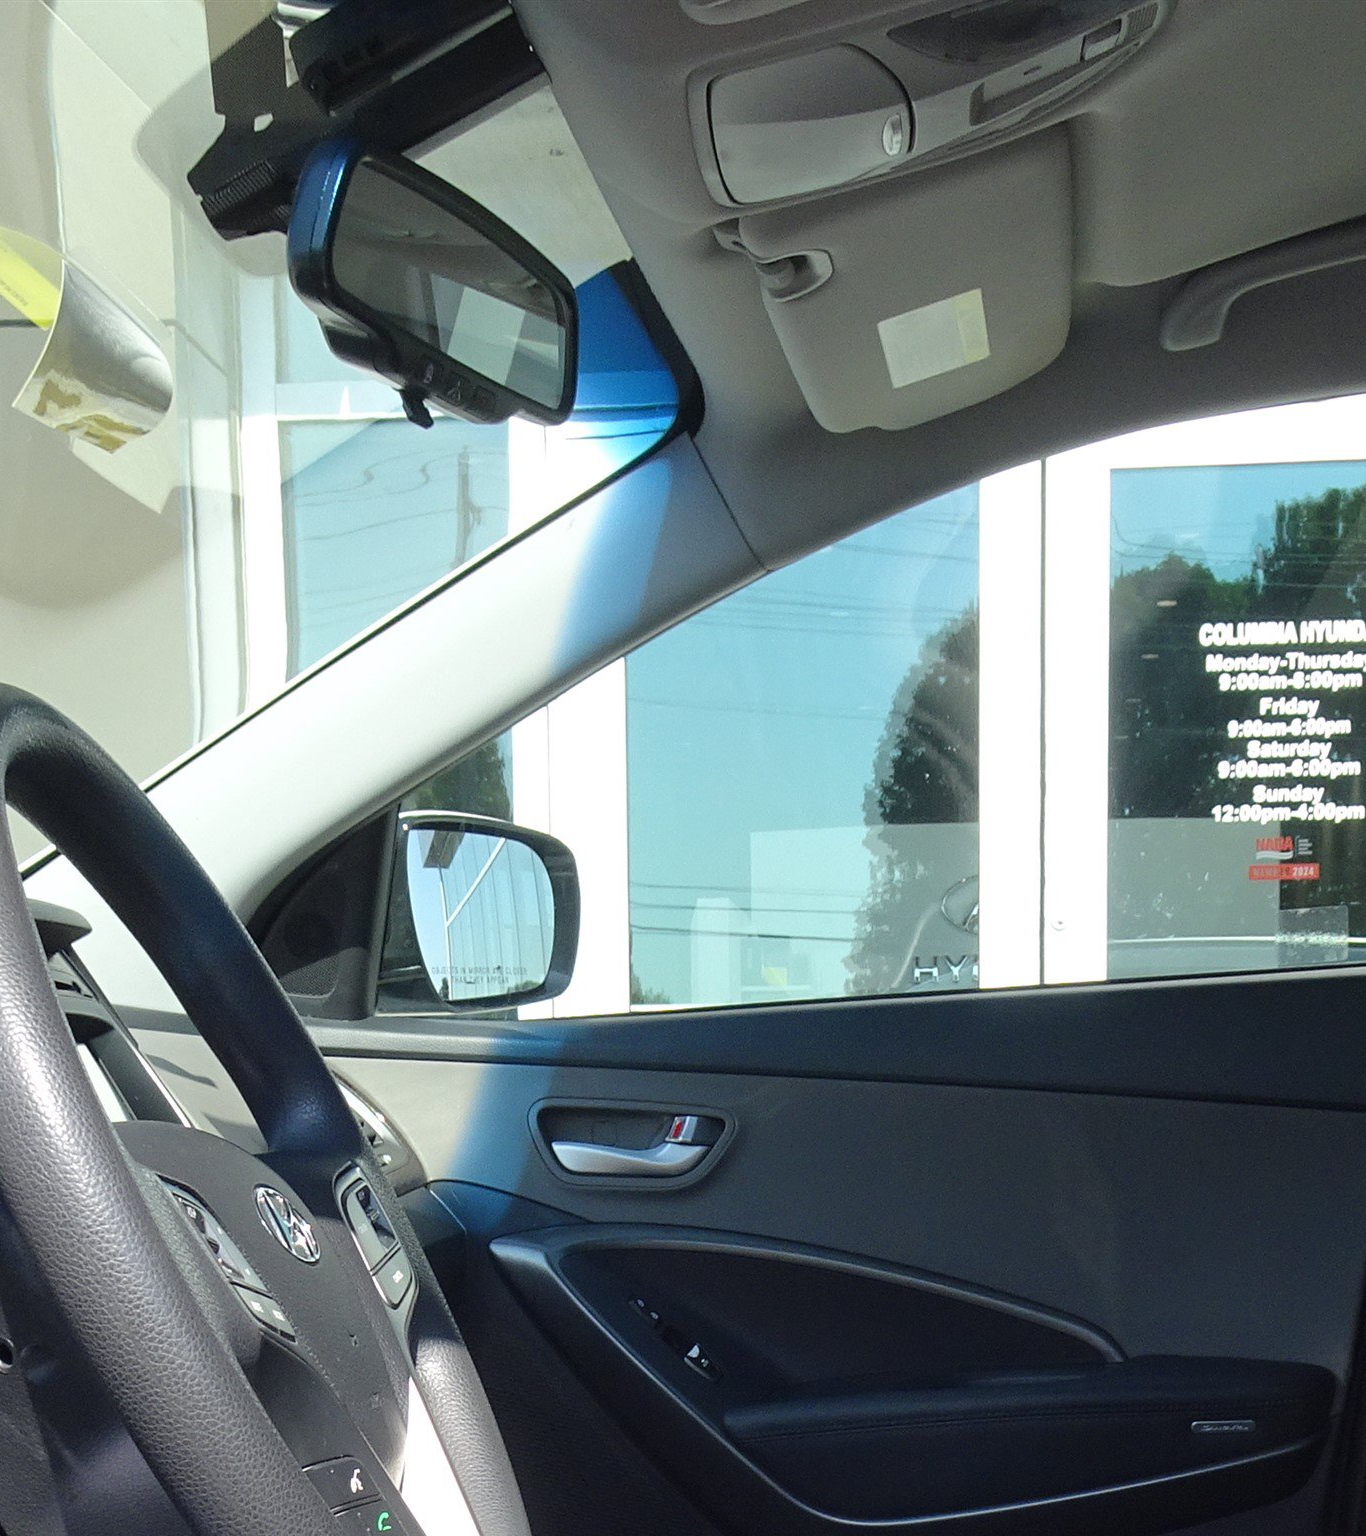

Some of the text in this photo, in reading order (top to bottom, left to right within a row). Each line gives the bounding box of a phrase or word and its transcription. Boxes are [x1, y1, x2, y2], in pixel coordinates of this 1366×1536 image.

[1199, 620, 1299, 646] COLUMBIA
[1259, 696, 1320, 718] Friday
[1227, 717, 1352, 739] 9:00am-6:00pm
[1247, 739, 1332, 760] Saturday
[1217, 758, 1362, 780] 9:00am-6:00pm
[1253, 784, 1325, 805] Sunday
[1211, 802, 1366, 826] 12:00pm-4:00pm
